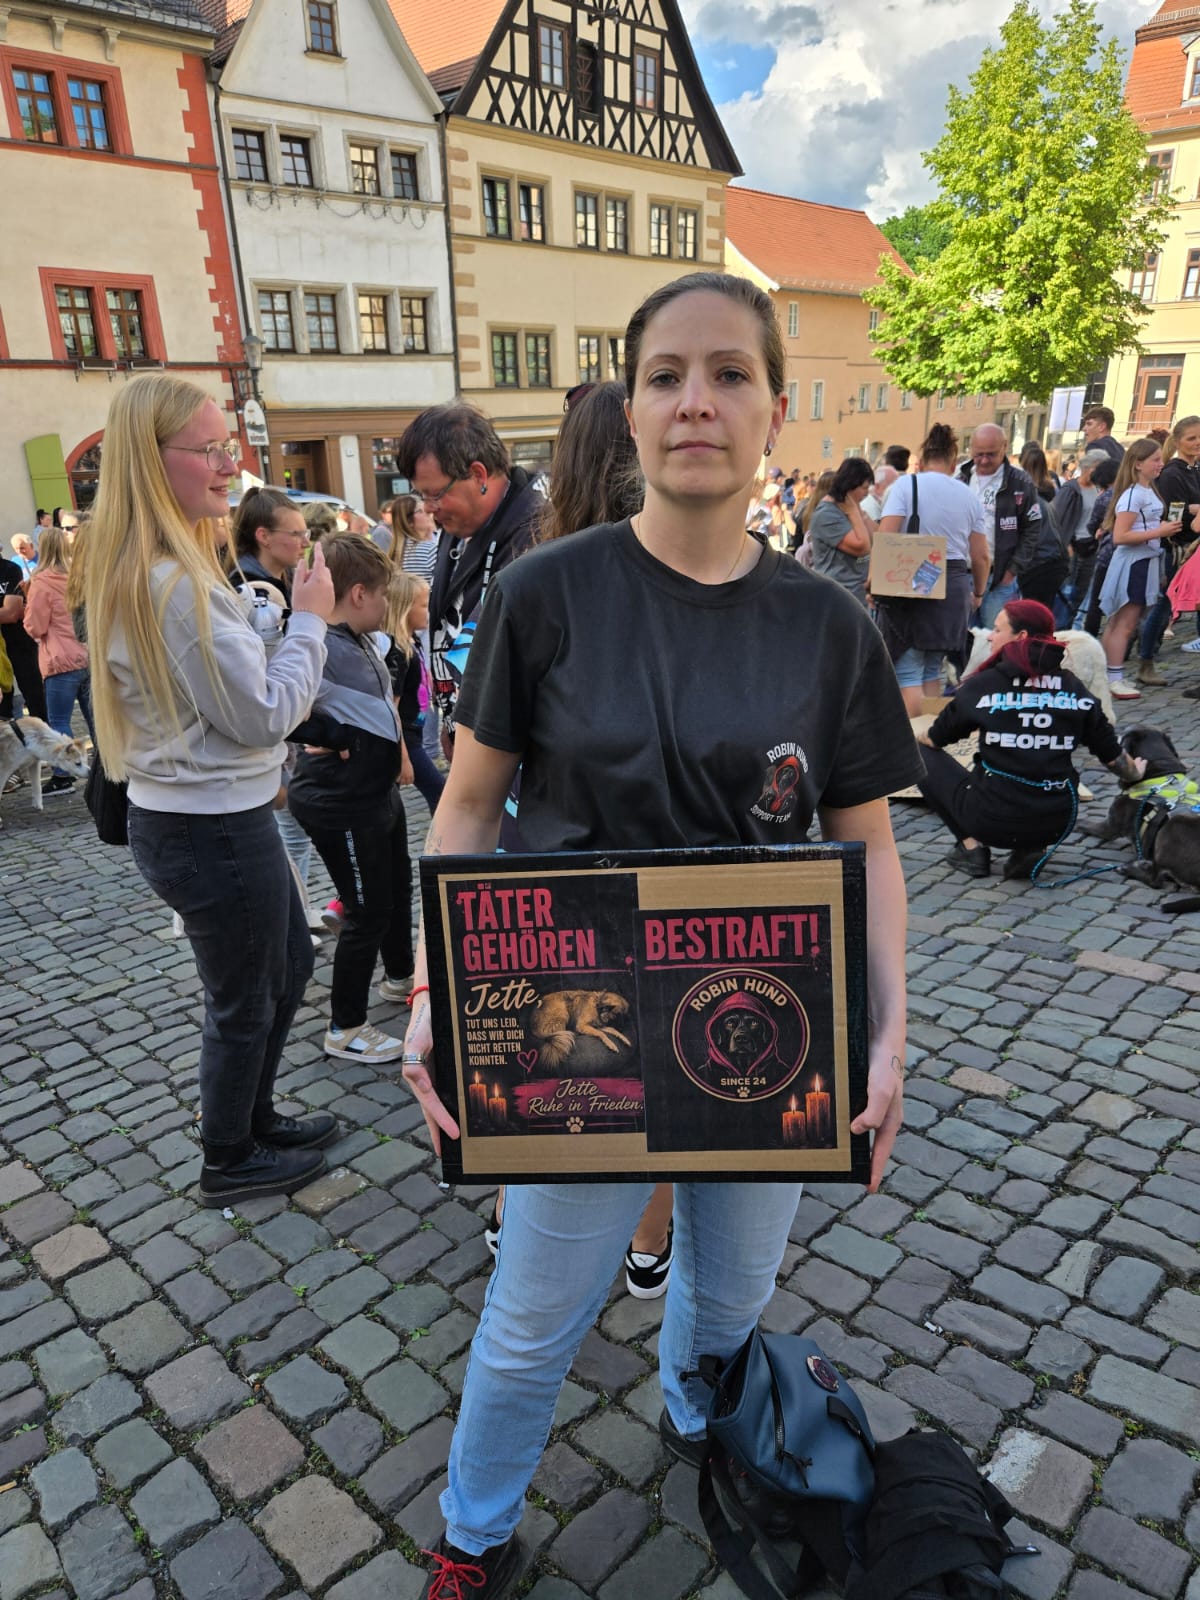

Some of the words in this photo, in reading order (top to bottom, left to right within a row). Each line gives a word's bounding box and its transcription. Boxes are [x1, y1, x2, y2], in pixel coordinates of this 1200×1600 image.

[1024, 675, 1062, 690] AM
[975, 691, 1095, 711] ALLERGIC
[1018, 713, 1053, 728] TO
[985, 731, 1075, 750] PEOPLE
[766, 742, 796, 763] ROBIN
[457, 882, 554, 931] TÄTER
[644, 913, 820, 961] BESTRAFT!
[463, 928, 596, 972] GEHÖREN
[464, 978, 543, 1016] Jette,
[690, 978, 738, 1012] ROBIN
[744, 978, 788, 1007] HUND
[465, 1019, 480, 1029] TUT
[482, 1018, 498, 1029] UNS
[466, 1031, 487, 1041] DASS
[489, 1030, 504, 1041] WIR
[506, 1029, 525, 1040] DICH
[467, 1043, 490, 1054] NICHT
[493, 1042, 521, 1053] RETTEN
[469, 1055, 508, 1066] KONNTEN.
[556, 1079, 599, 1098] Jette
[720, 1077, 751, 1086] SINCE
[752, 1077, 767, 1086] 24
[528, 1097, 565, 1116] Ruhe
[568, 1099, 583, 1111] in
[587, 1095, 644, 1112] Frieden.
